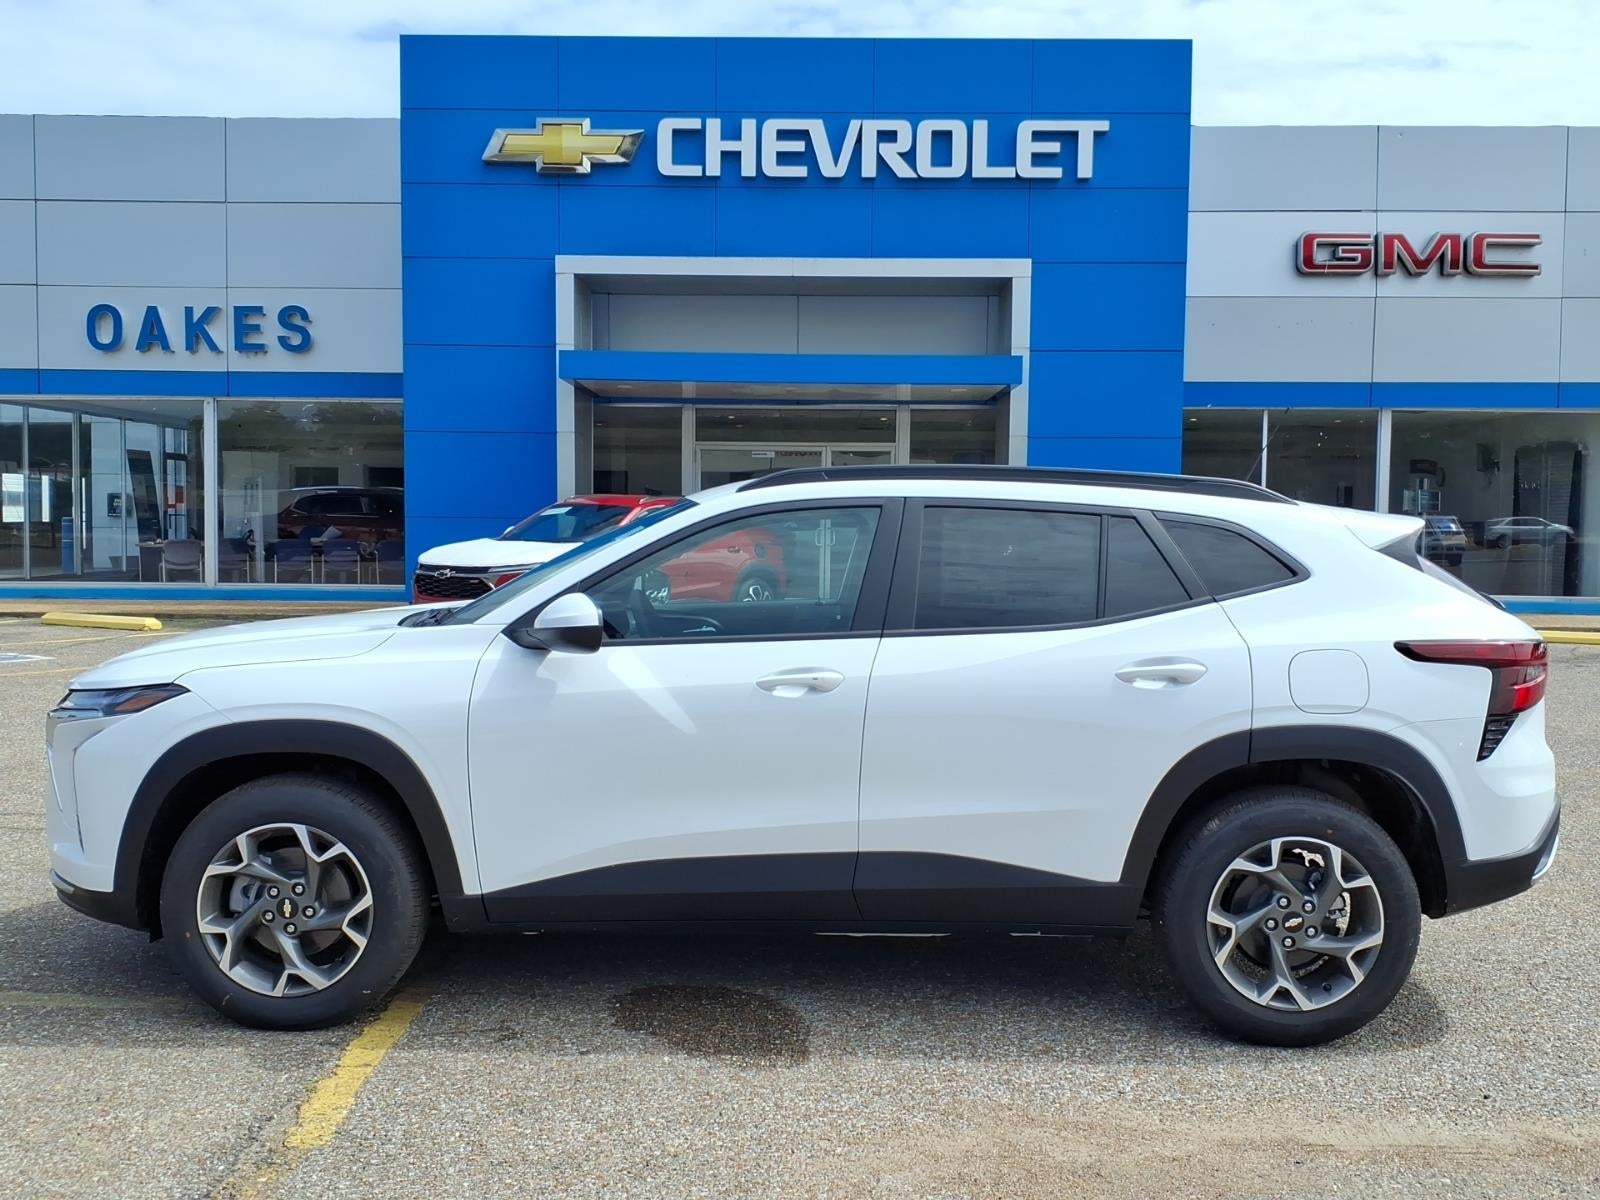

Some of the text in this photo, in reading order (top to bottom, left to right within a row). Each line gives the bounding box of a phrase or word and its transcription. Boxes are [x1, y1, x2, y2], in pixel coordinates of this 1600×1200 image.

[656, 117, 1110, 181] CHEVROLET
[1297, 231, 1542, 276] GMC
[86, 303, 313, 354] OAKES
